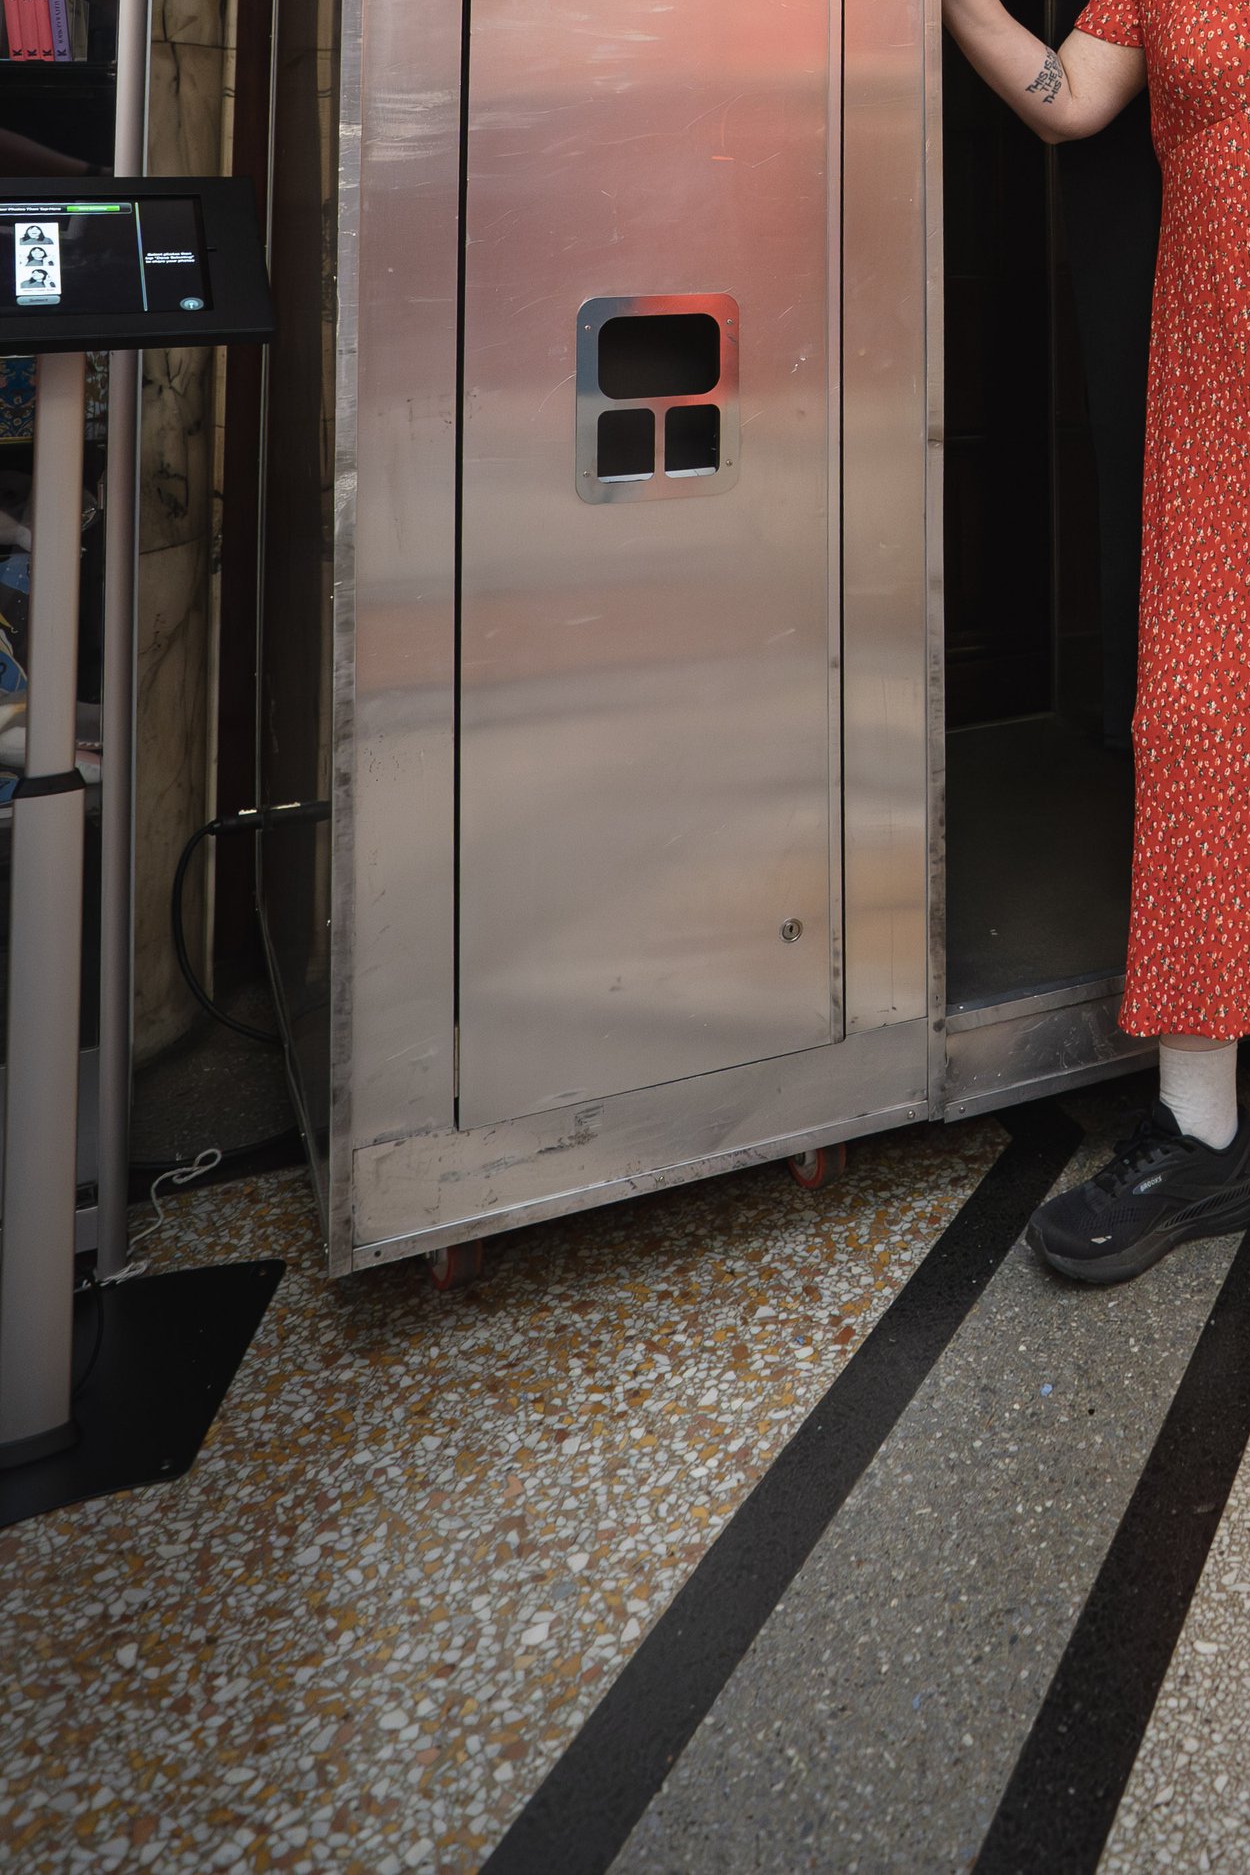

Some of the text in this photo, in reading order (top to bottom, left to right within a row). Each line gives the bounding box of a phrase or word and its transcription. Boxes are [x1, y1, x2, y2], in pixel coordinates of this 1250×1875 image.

[1025, 71, 1049, 93] THIS
[1044, 59, 1052, 71] IS
[1040, 71, 1058, 92] THE
[1043, 80, 1062, 104] THIS
